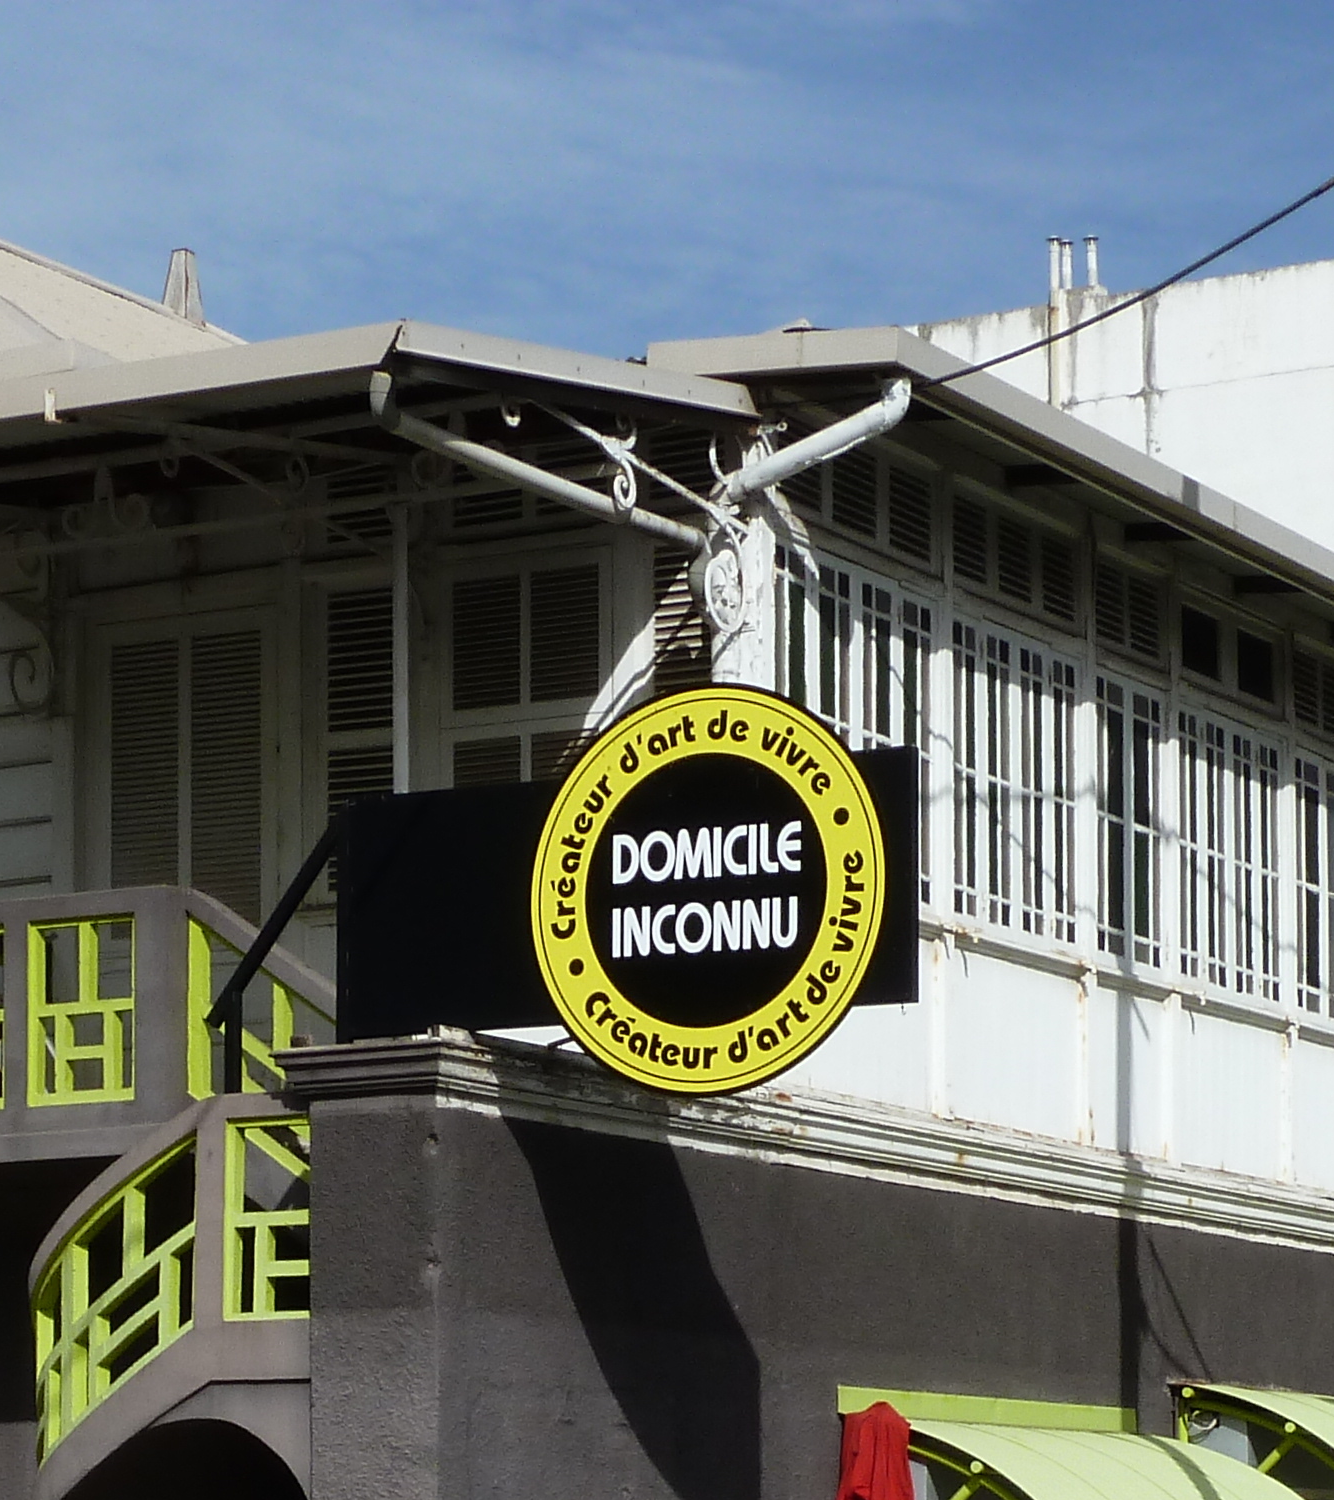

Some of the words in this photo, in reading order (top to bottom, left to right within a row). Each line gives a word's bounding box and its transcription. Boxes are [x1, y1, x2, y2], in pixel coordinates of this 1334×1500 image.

[550, 772, 615, 941] Créateur
[619, 708, 697, 776] d'art
[705, 708, 750, 743] de
[760, 725, 833, 797] vivre
[611, 819, 803, 886] DOMICILE
[583, 989, 720, 1070] Créateur
[726, 996, 812, 1064] d'art
[805, 957, 842, 1007] de
[827, 848, 866, 954] vivre
[611, 895, 800, 959] INCONNU
